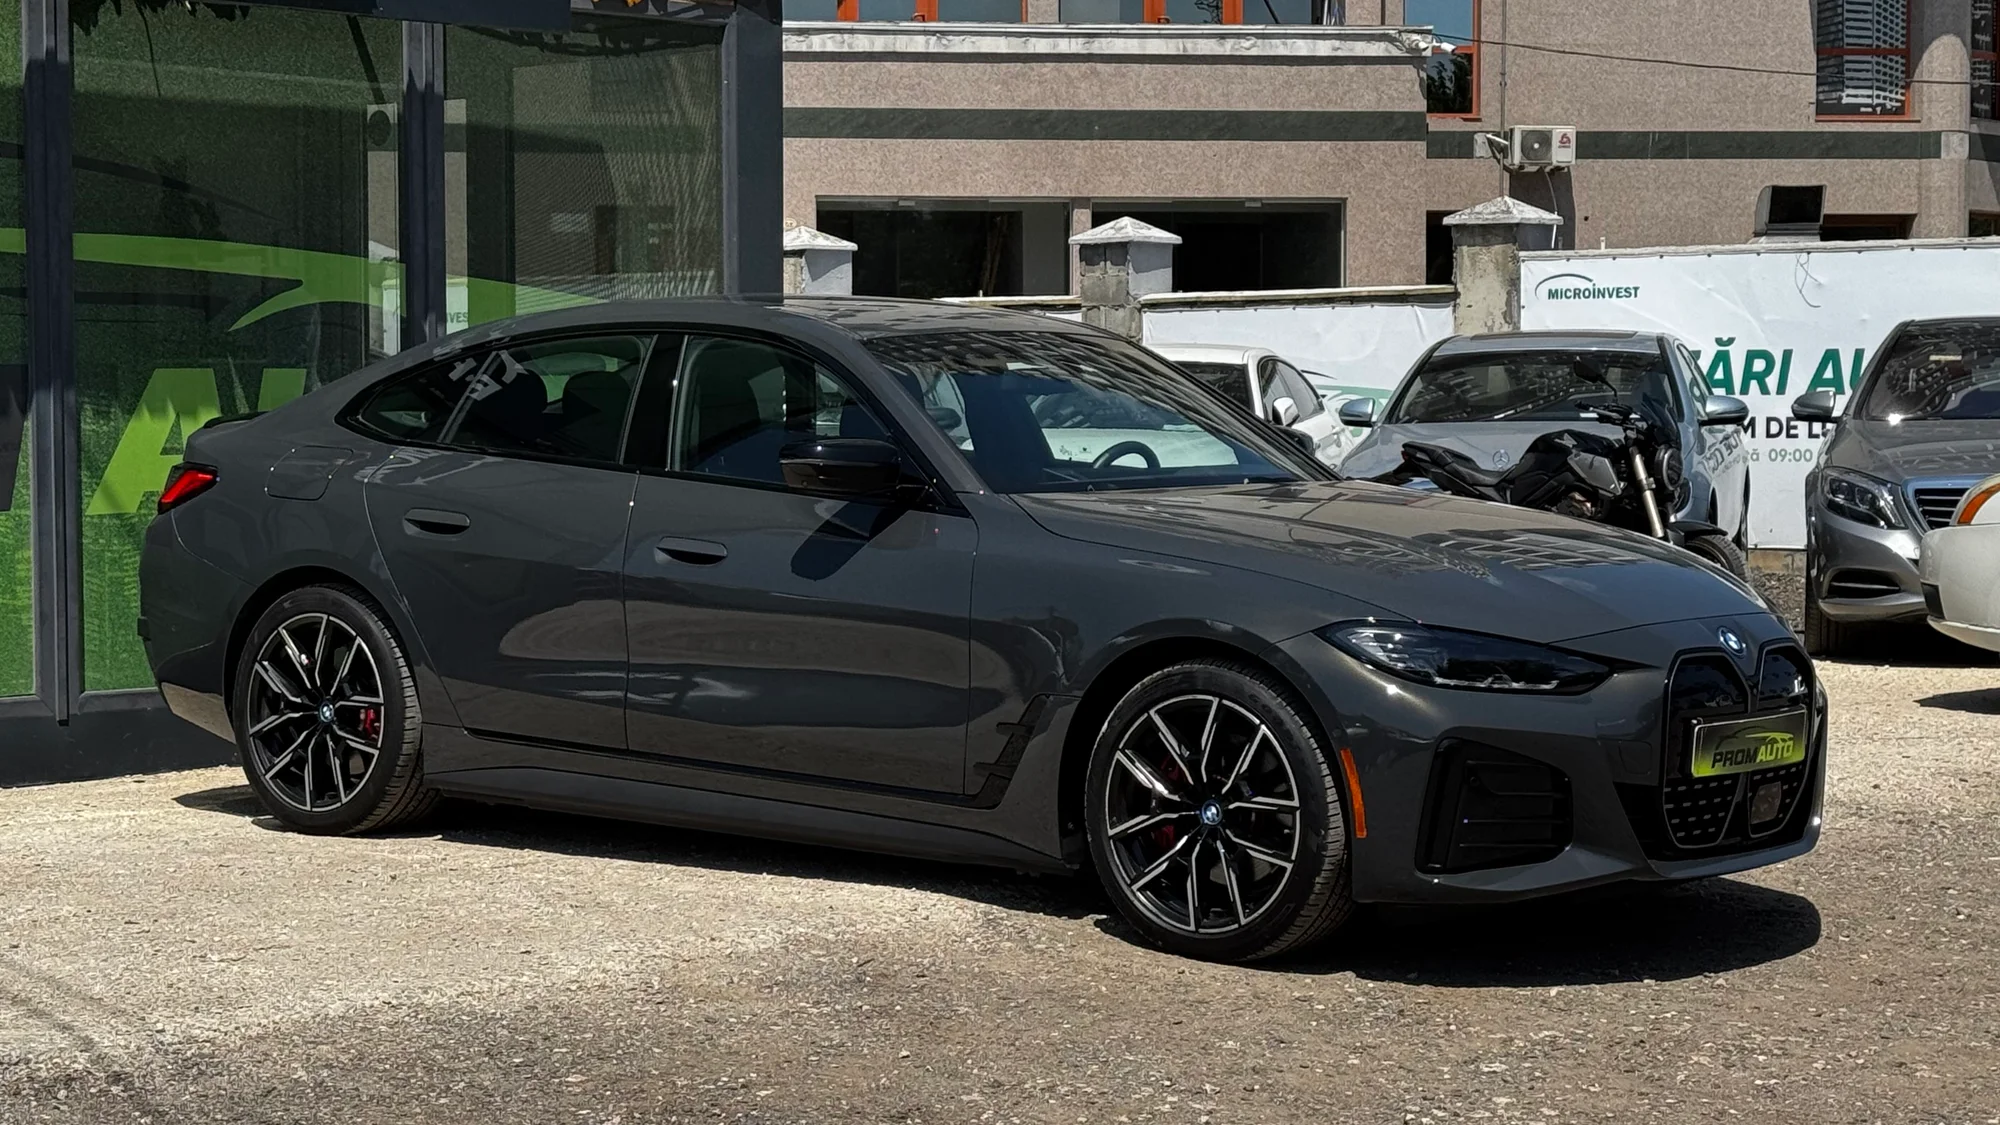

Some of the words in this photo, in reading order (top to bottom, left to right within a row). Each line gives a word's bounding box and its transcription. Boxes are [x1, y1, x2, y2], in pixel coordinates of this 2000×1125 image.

[1690, 337, 1794, 396] ĂRI
[1765, 416, 1799, 439] DE
[1768, 448, 1813, 463] 09:00
[1711, 741, 1794, 769] PROMAUTO
